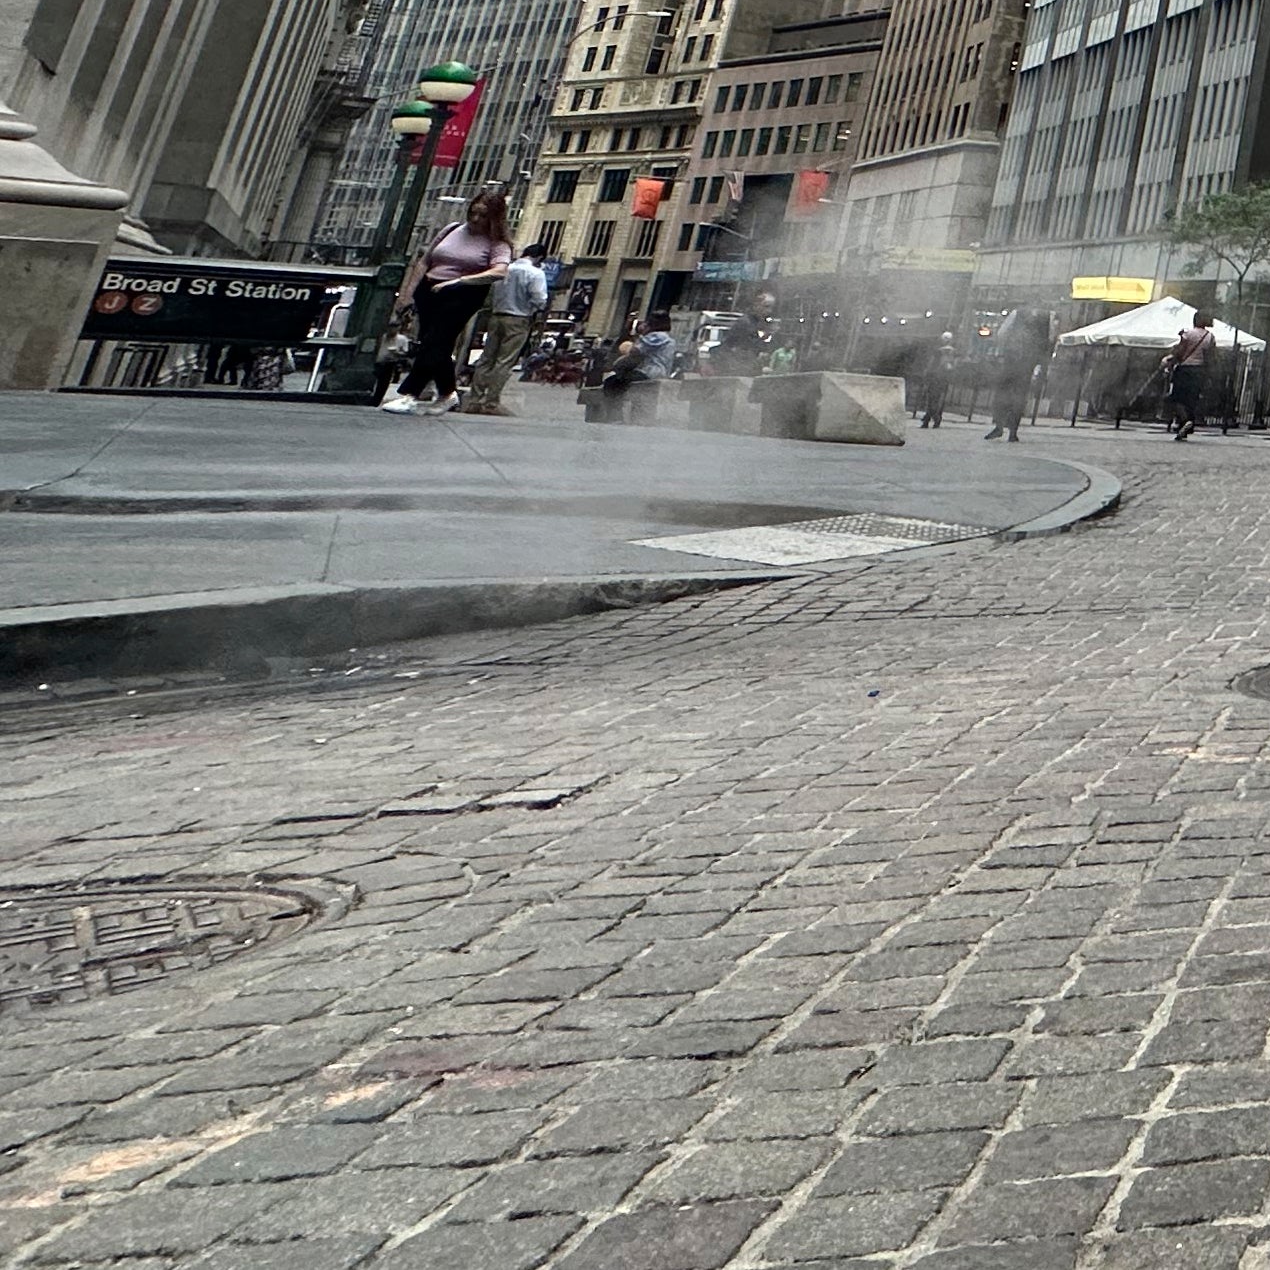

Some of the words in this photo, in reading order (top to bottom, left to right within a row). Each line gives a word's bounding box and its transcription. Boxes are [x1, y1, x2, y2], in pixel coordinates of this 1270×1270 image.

[102, 273, 181, 293] Broad
[187, 279, 218, 296] St
[225, 281, 311, 300] Station
[105, 295, 119, 309] J
[138, 297, 154, 311] Z
